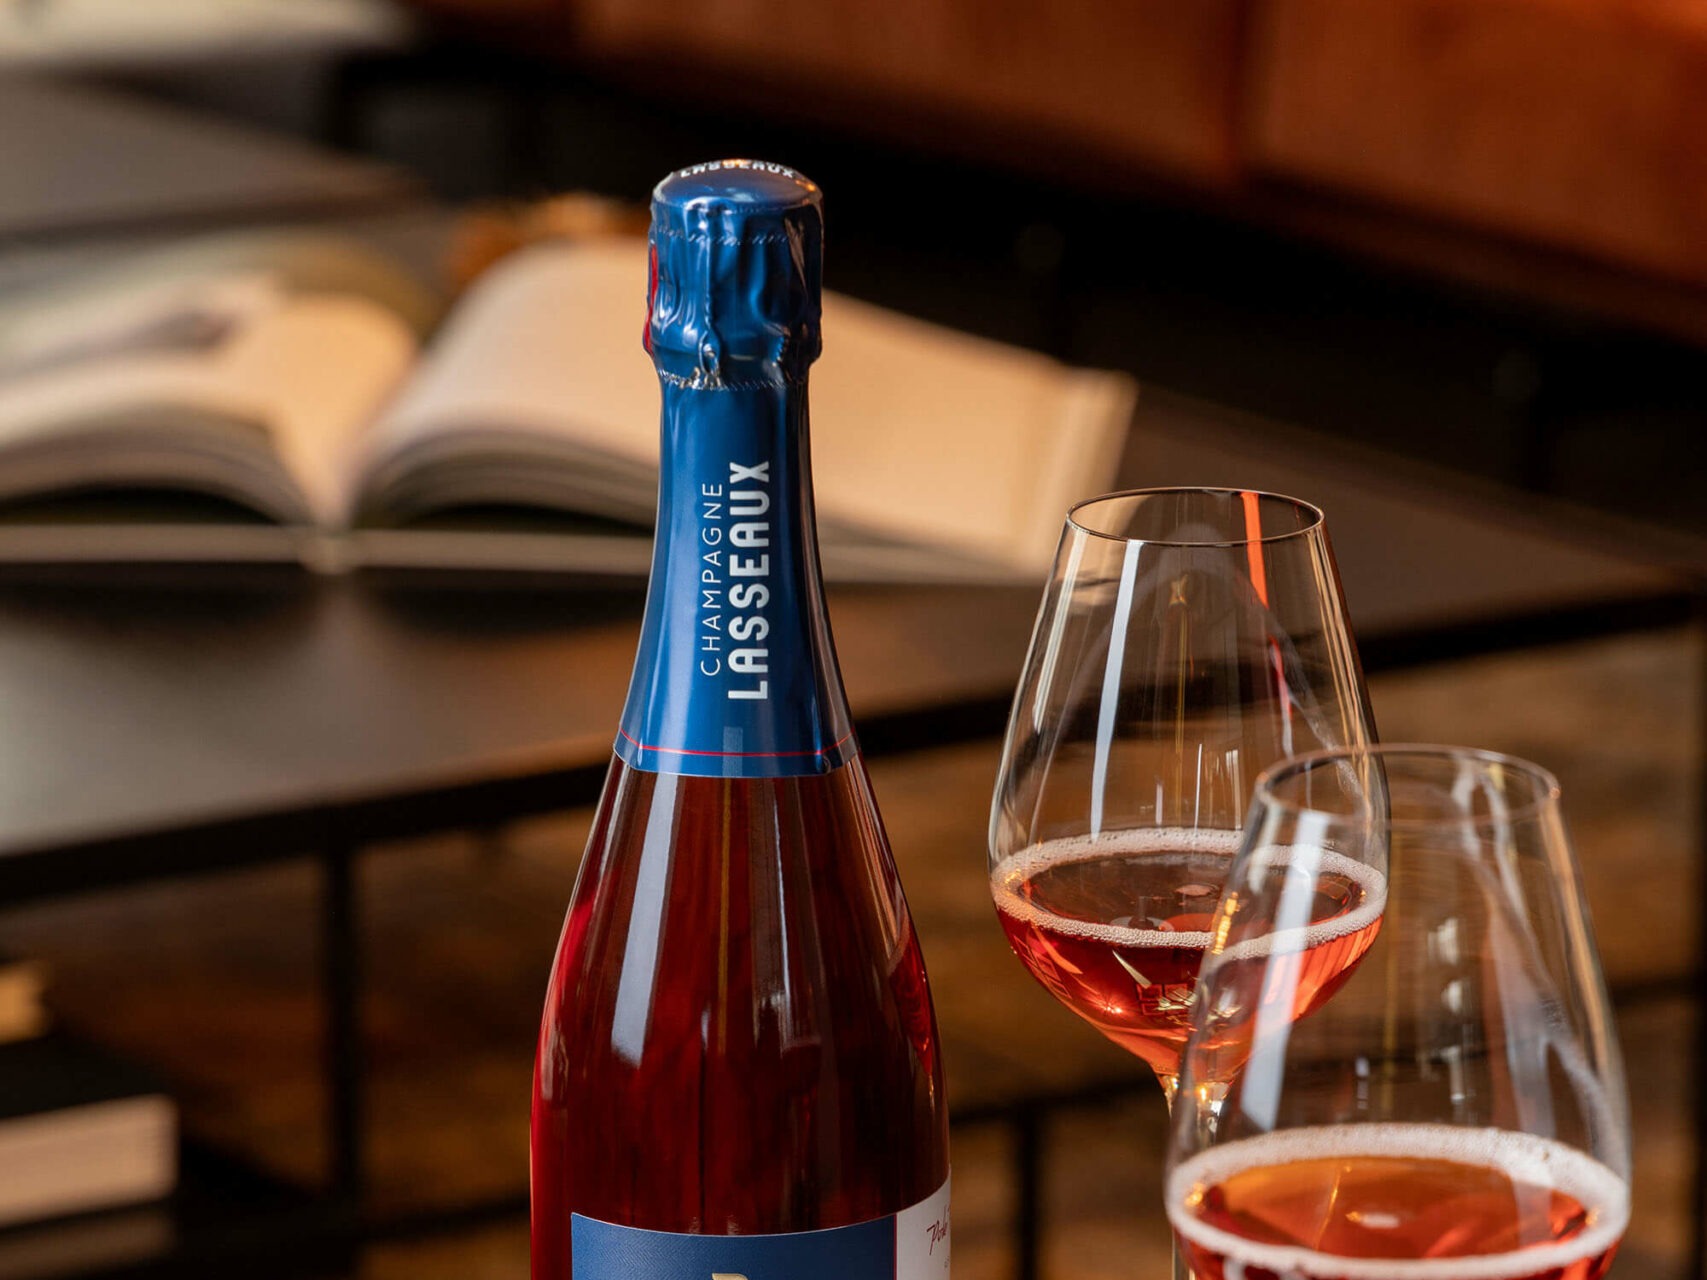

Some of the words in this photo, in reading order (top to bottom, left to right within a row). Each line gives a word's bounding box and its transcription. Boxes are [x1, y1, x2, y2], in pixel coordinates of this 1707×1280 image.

[680, 158, 795, 178] LASSEAUX
[700, 483, 722, 677] CHAMPAGNE
[727, 460, 770, 700] LASSEAUX
